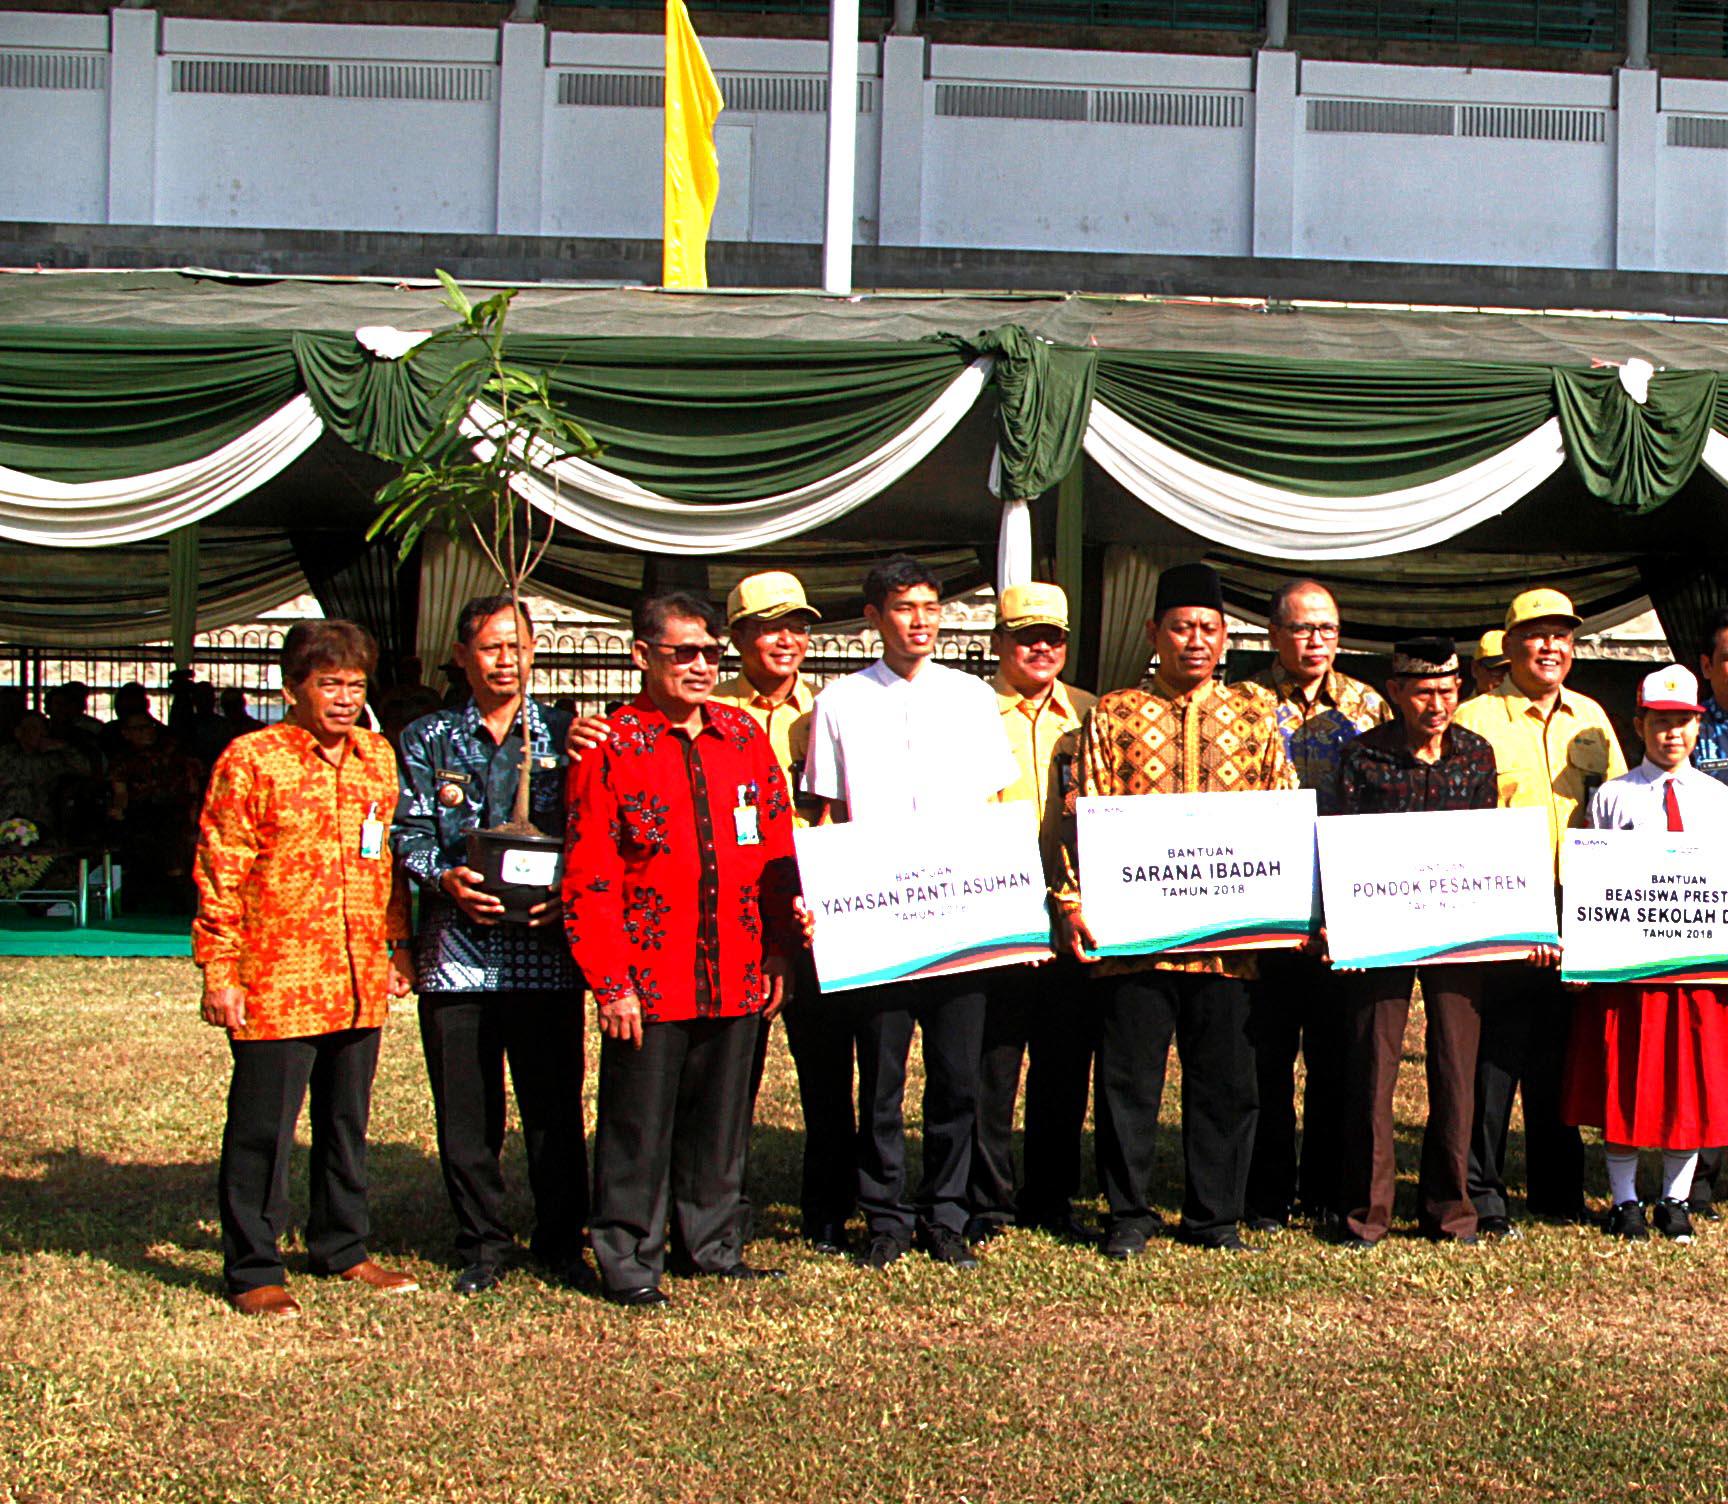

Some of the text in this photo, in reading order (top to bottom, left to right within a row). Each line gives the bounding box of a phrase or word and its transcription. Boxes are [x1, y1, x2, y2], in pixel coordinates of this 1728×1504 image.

[1168, 847, 1234, 858] BANTUAN
[1122, 861, 1281, 883] SARANA IBADAH
[1651, 874, 1707, 885] BANTUAN
[1162, 885, 1245, 896] TAHUN 2018
[1353, 875, 1526, 898] PONDOK PESANTREN
[822, 872, 1031, 915] YAYASAN PANTI ASUHAN
[1605, 889, 1678, 902] BEASISWA
[1577, 906, 1630, 922] SISWA
[1637, 908, 1716, 924] SEKOLAH
[1643, 929, 1713, 939] TAHUN 2018
